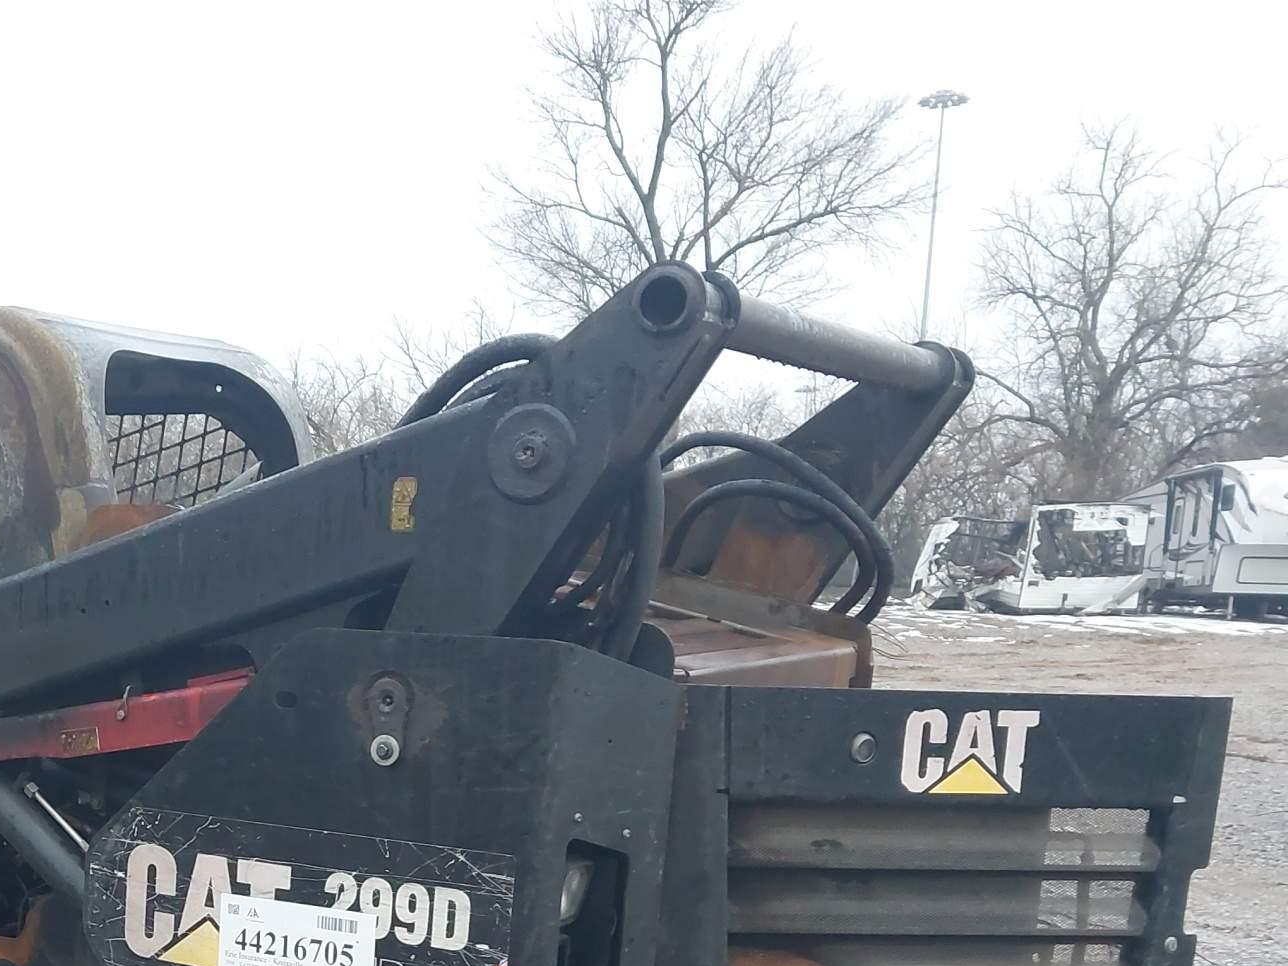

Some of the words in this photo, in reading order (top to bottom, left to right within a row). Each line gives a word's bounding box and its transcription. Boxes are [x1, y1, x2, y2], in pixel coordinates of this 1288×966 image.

[901, 709, 1041, 794] CAT
[124, 843, 292, 959] CAT
[324, 872, 472, 952] 299D
